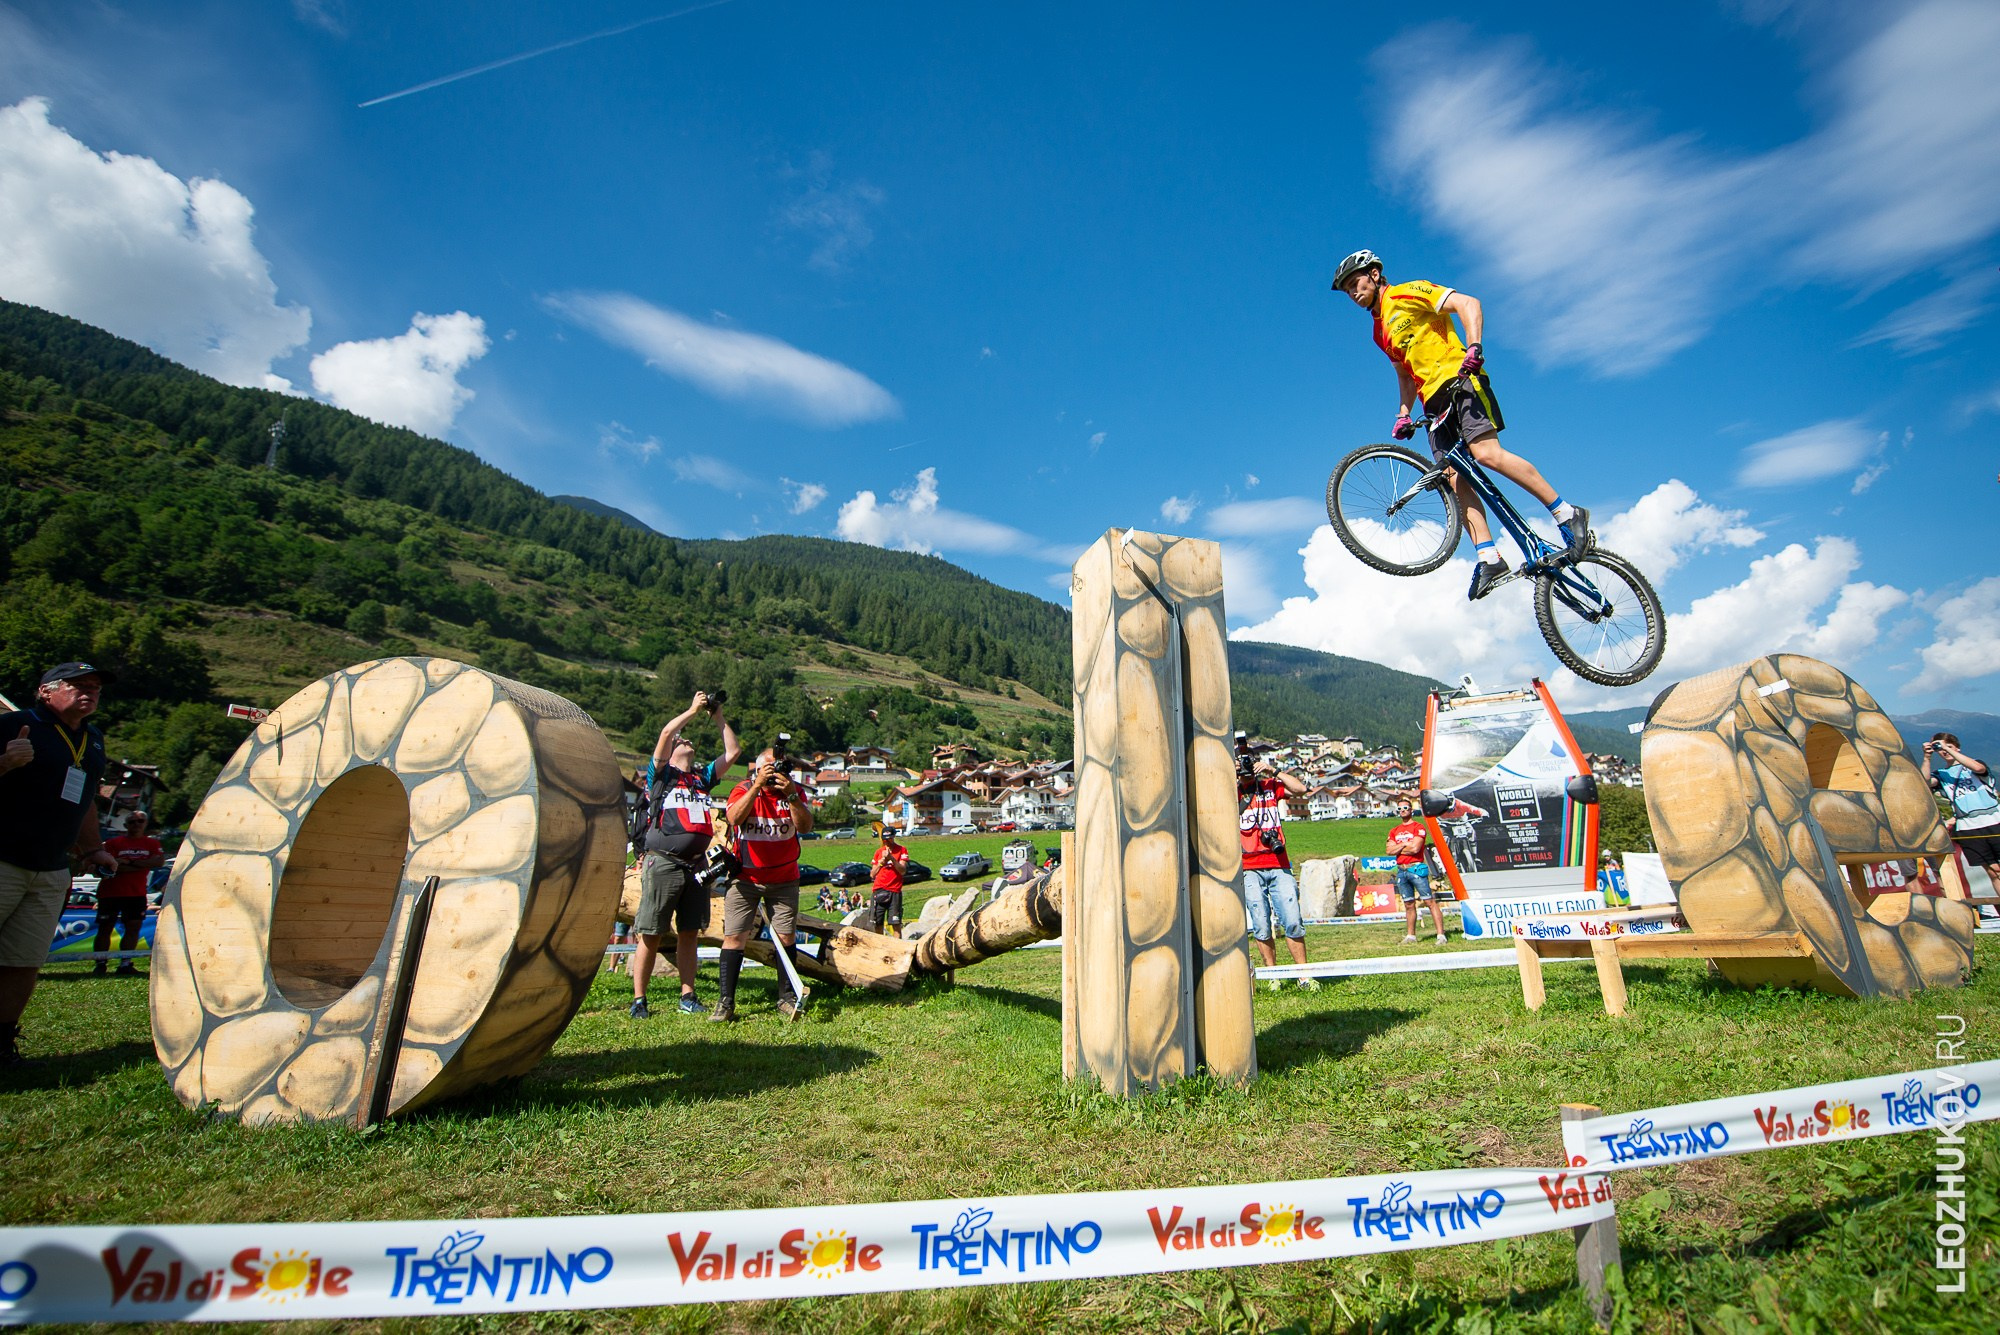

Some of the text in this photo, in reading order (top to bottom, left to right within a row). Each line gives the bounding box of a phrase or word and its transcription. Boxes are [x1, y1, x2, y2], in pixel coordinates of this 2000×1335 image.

[675, 792, 711, 806] PHO
[1498, 789, 1533, 800] WORLD
[1240, 812, 1269, 824] HOO
[1509, 808, 1530, 817] 2016
[747, 823, 789, 835] PHOTO
[1512, 836, 1538, 844] TRENTINO
[1513, 853, 1523, 861] 4X
[1528, 852, 1553, 860] TRIALS
[1527, 923, 1571, 938] TRENTINO
[1580, 921, 1598, 936] Val
[1598, 927, 1605, 935] di
[1605, 921, 1625, 935] Sole
[1628, 920, 1663, 934] TRENTINO
[1600, 1121, 1729, 1164] TRENTINO
[1754, 1106, 1794, 1145] Val
[1798, 1117, 1814, 1139] di
[1814, 1100, 1870, 1137] Sole
[102, 1173, 1613, 1307] Val di Sole TRENTINO Val di Sole TRENTINO Val di Sole TRENTINO Val di
